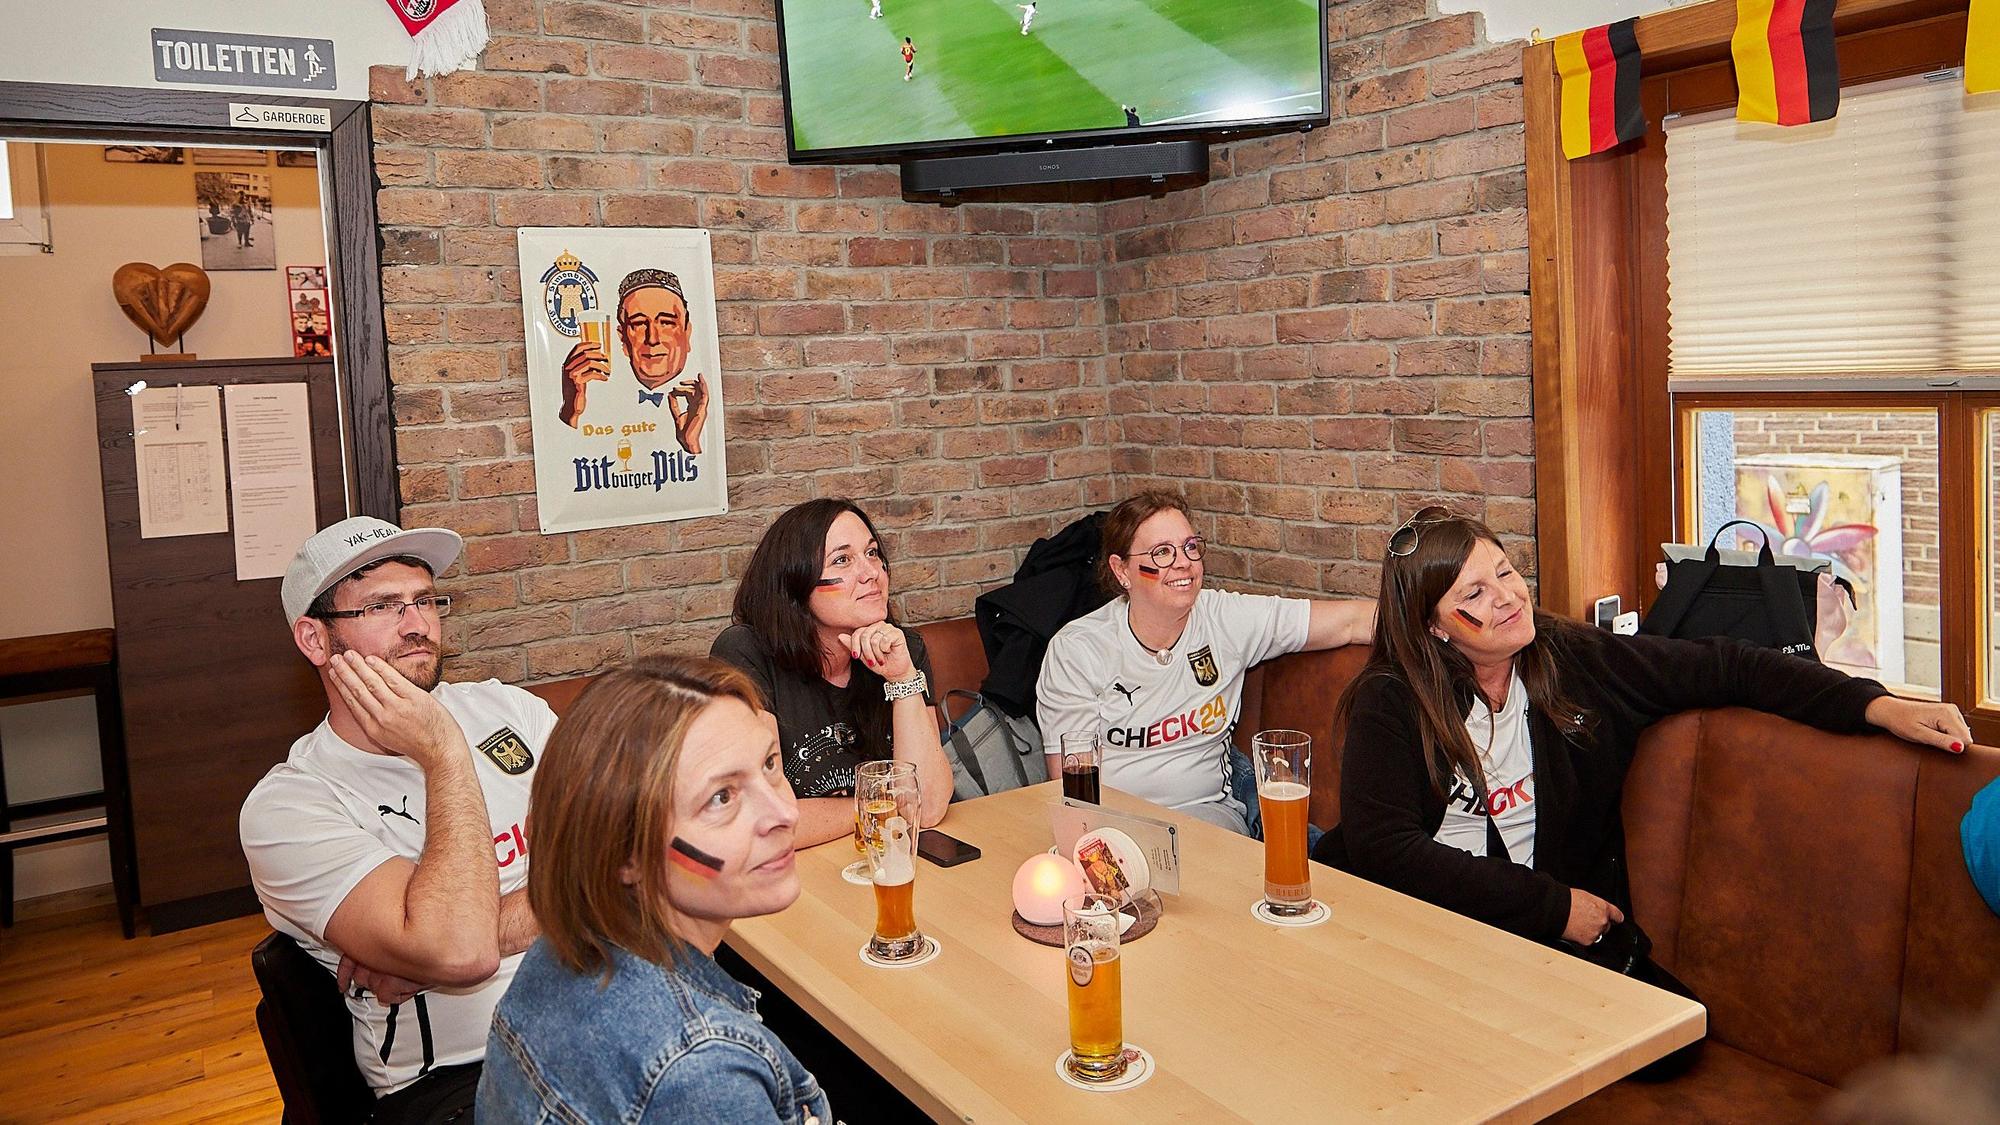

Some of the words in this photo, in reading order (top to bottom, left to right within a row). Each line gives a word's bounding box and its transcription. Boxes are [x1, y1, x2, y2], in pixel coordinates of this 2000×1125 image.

[157, 40, 296, 76] TOILETTEN
[263, 111, 326, 125] GARDEROBE
[582, 424, 614, 436] Das
[621, 421, 656, 436] gute
[1107, 694, 1226, 748] CHECK24
